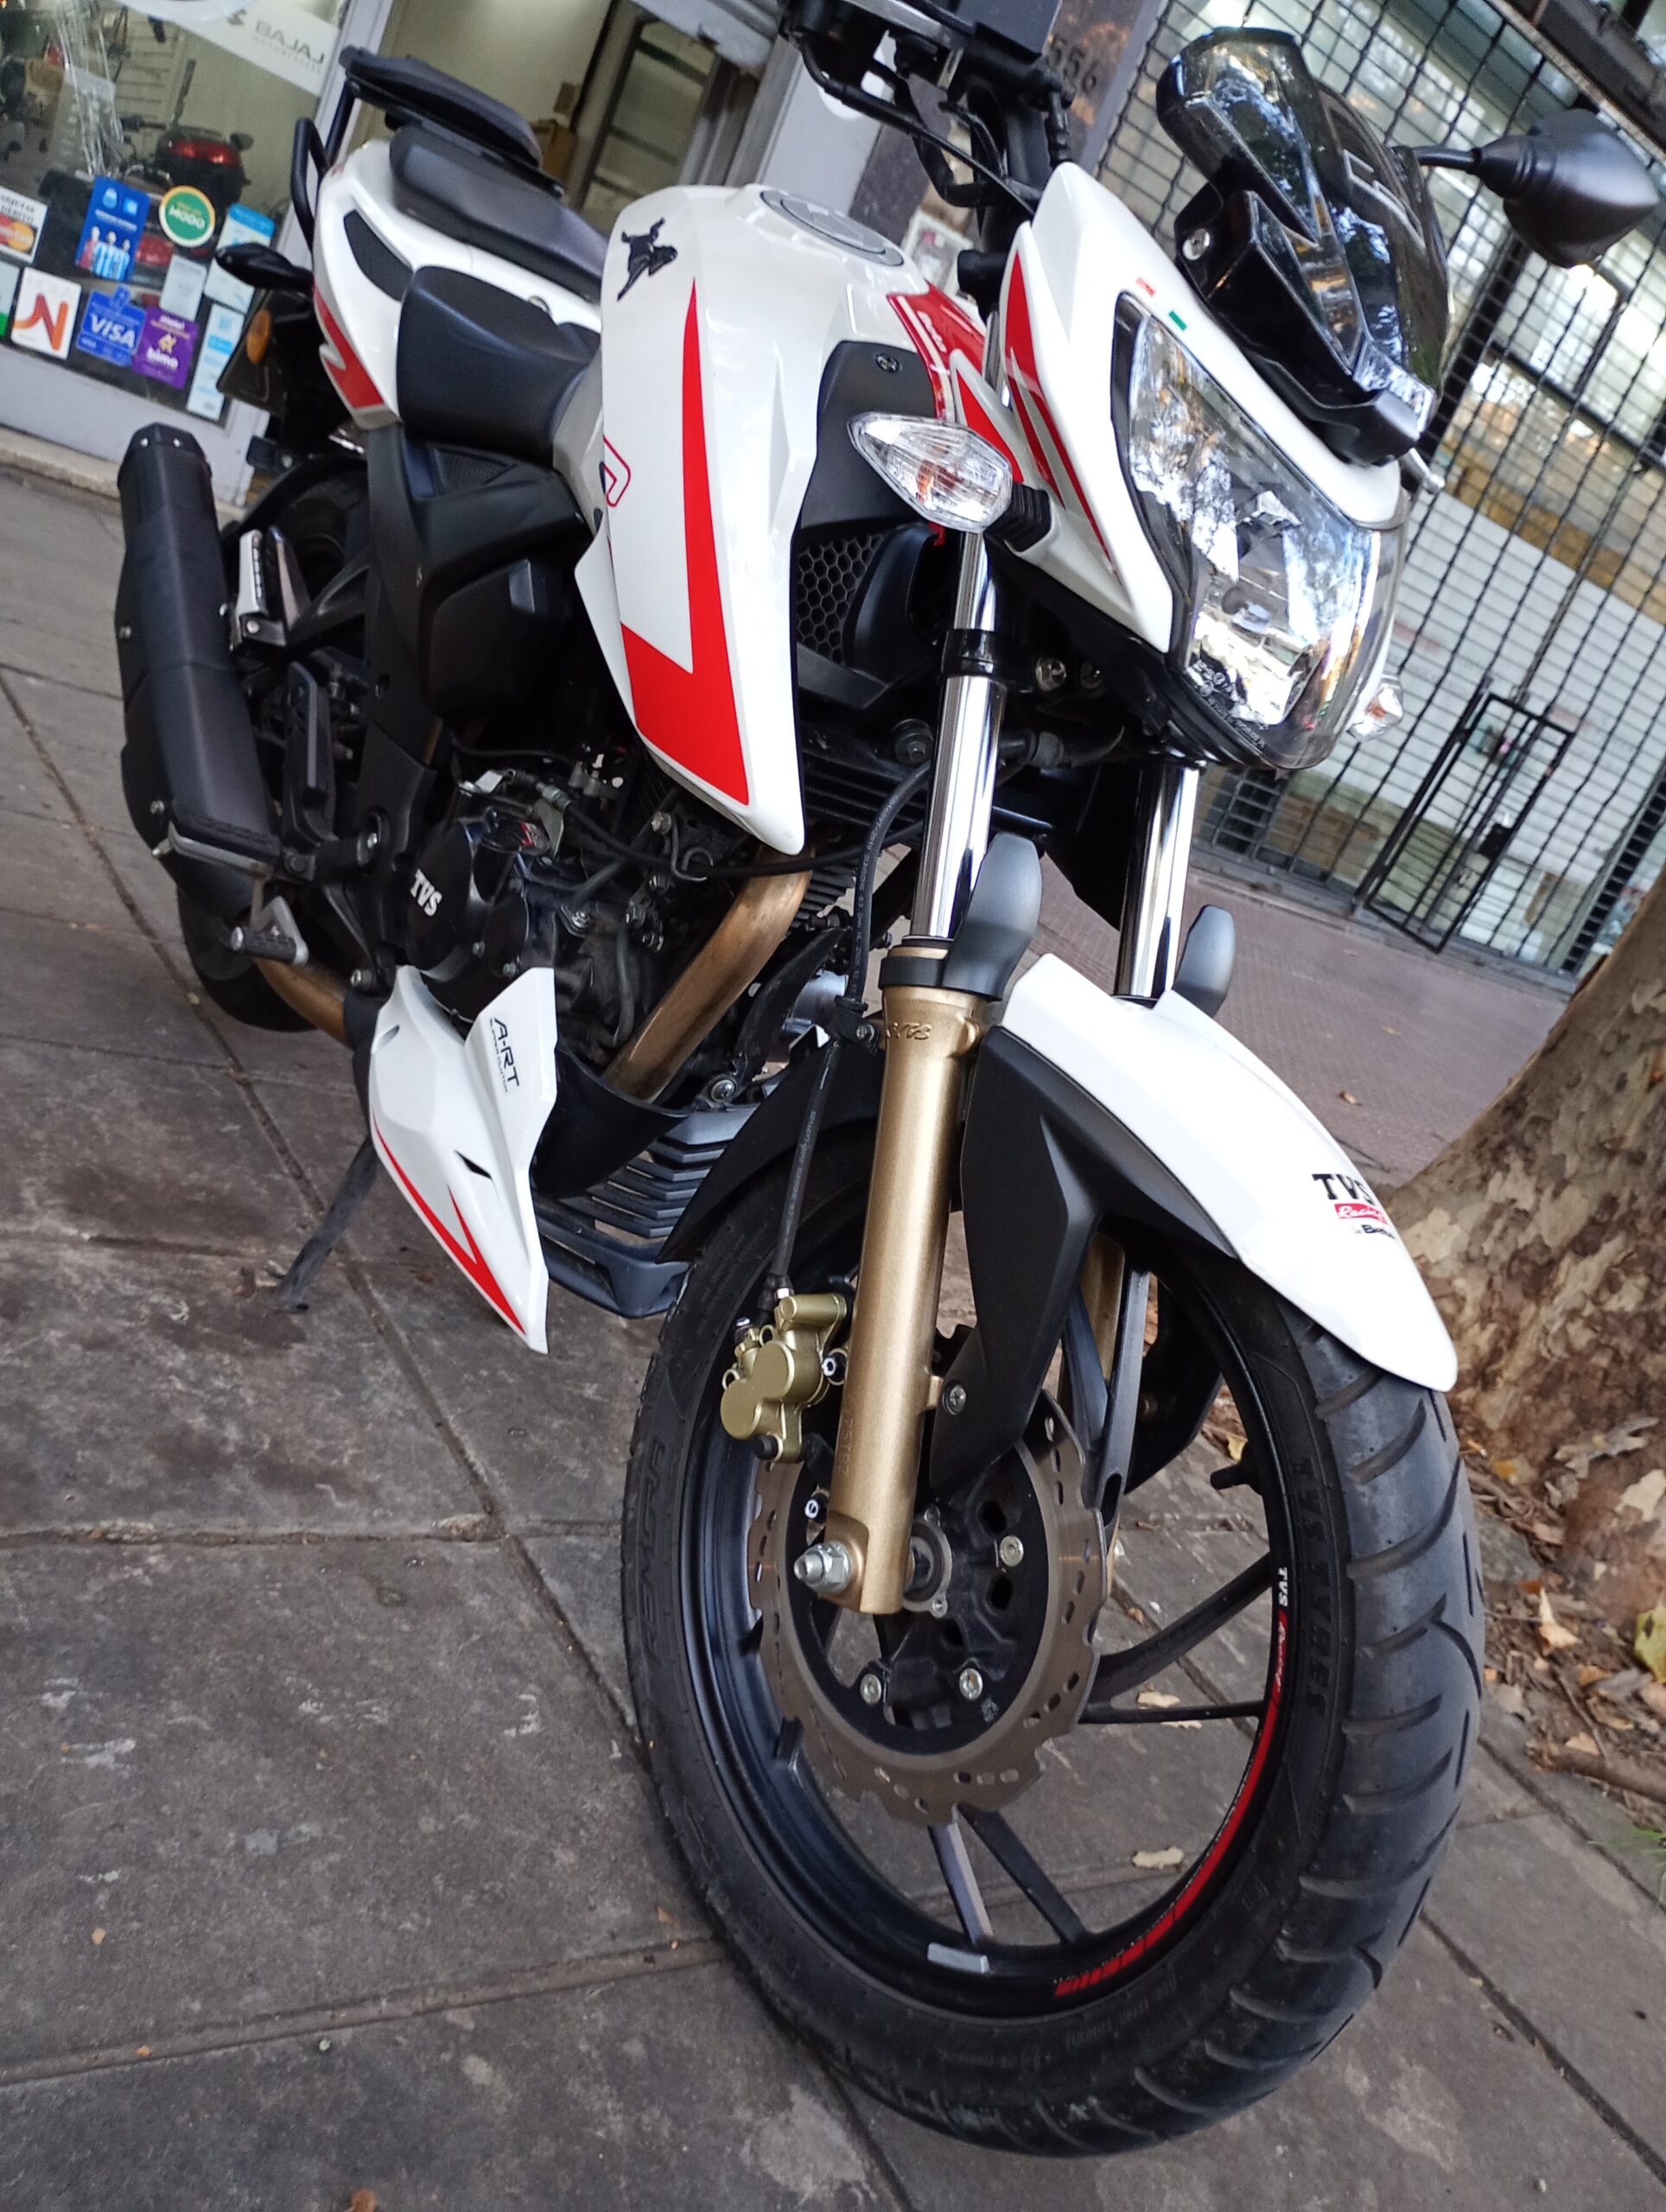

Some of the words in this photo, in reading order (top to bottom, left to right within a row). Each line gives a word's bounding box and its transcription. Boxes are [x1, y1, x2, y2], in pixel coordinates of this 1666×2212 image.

[90, 311, 136, 349] VISA
[410, 868, 442, 917] TVS
[493, 1017, 520, 1087] A-RT
[1311, 1173, 1377, 1207] TVS
[1277, 1566, 1288, 1607] TVS
